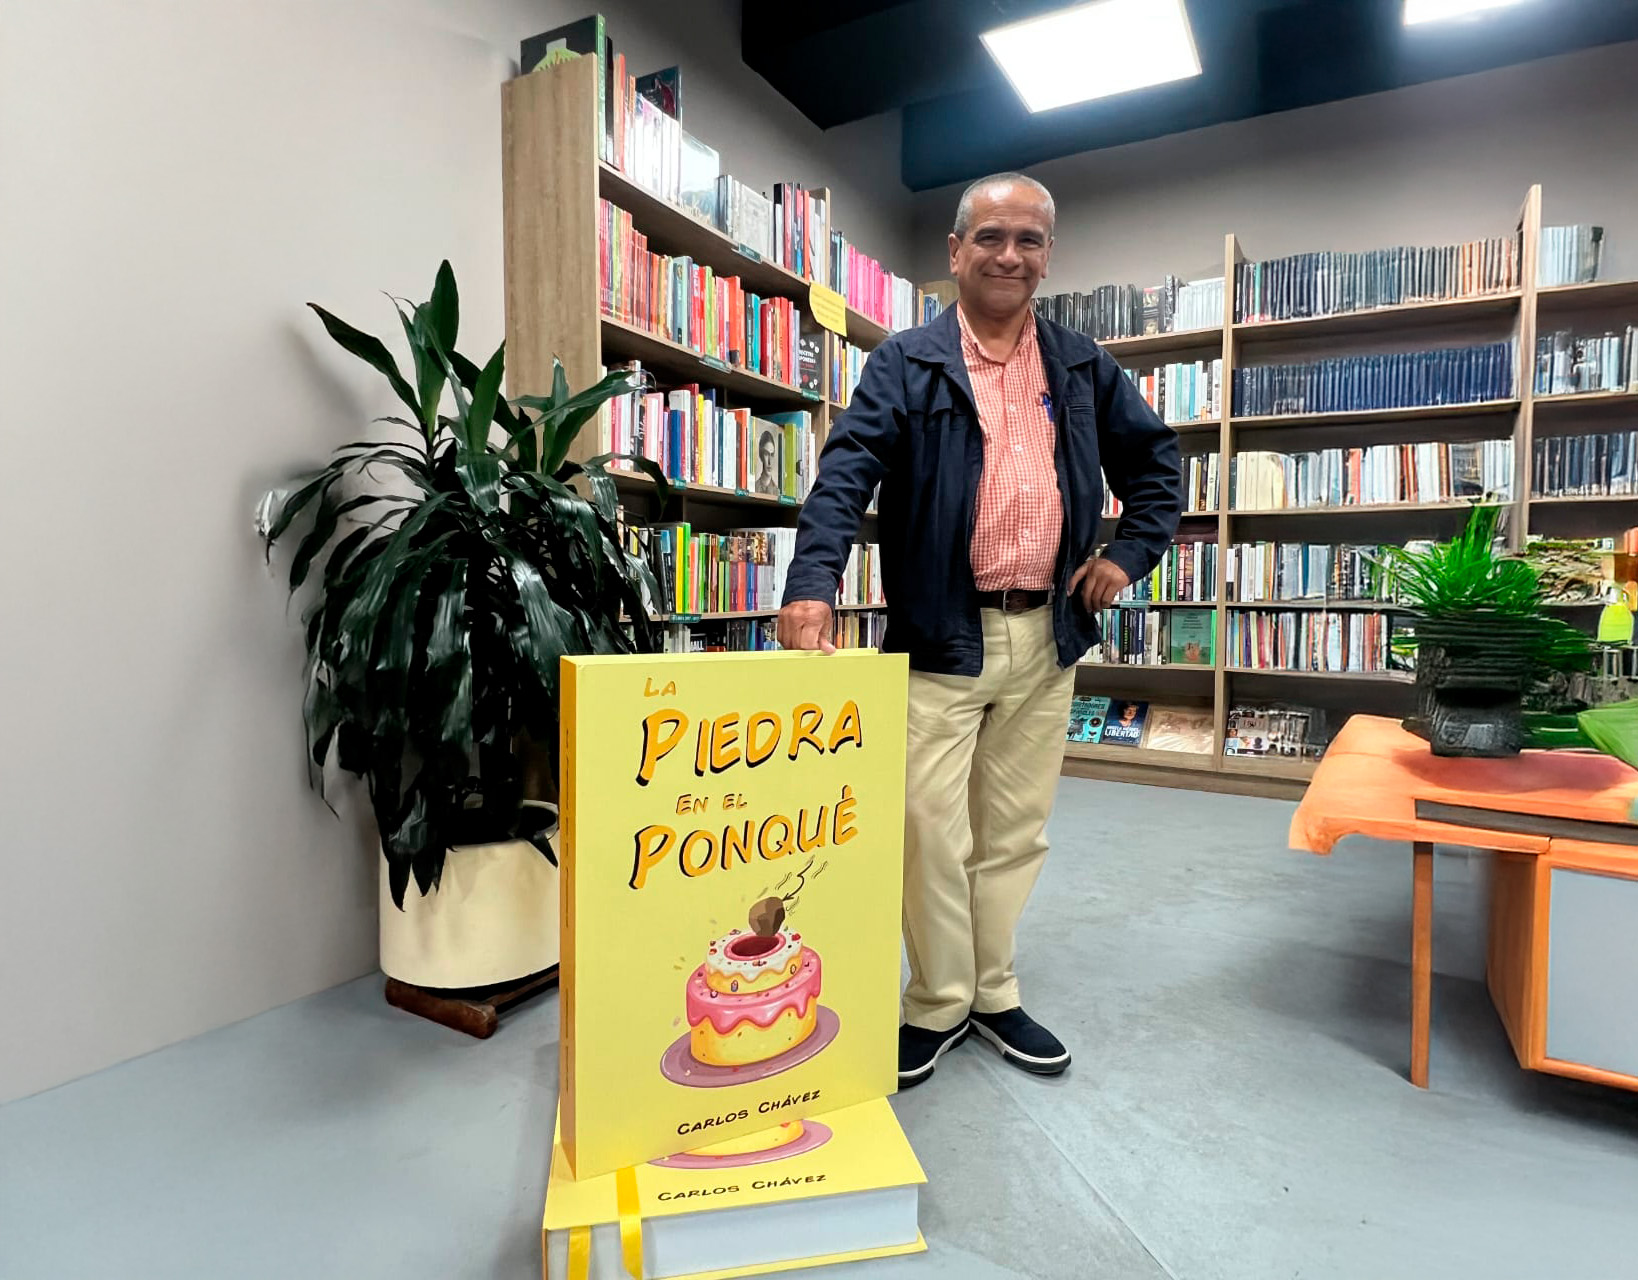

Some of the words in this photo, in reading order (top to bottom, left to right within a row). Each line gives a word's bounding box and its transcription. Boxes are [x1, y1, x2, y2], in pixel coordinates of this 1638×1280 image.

[644, 678, 676, 697] LA
[636, 700, 862, 786] PIEDRA
[676, 794, 708, 815] EN
[723, 793, 747, 810] EL
[629, 785, 858, 889] PONQUÉ
[677, 1110, 749, 1135] CARLOS
[758, 1090, 820, 1113] CHÁVEZ
[658, 1186, 739, 1201] CARLOS
[752, 1175, 826, 1189] CHÁVEZ
